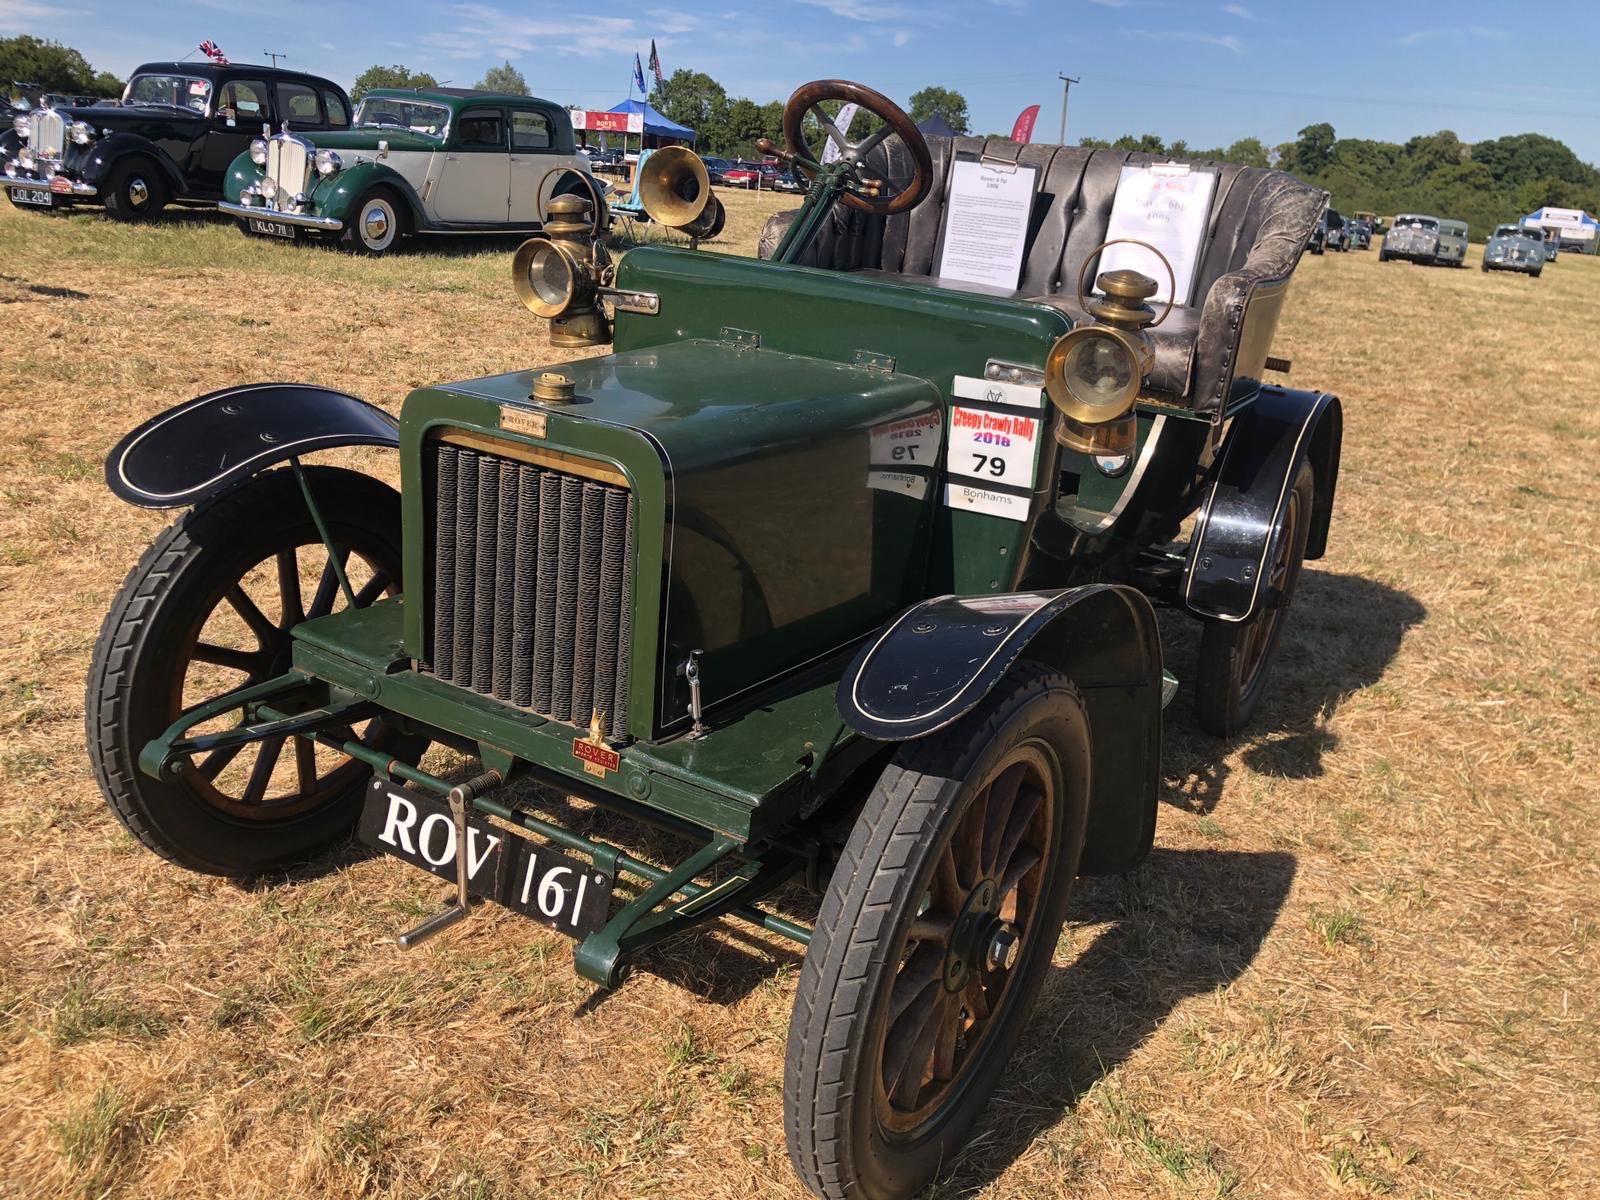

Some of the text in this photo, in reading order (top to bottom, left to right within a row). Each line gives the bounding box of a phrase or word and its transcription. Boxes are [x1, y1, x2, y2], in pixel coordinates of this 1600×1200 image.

[31, 191, 49, 202] 204
[256, 220, 274, 233] KLO
[508, 415, 539, 429] ROVER
[953, 407, 1035, 442] Creepy Crawly Rally
[973, 432, 1011, 448] 2018
[972, 453, 1006, 477] 79
[963, 487, 1013, 504] Bonhams
[578, 743, 614, 762] ROVER
[378, 792, 588, 927] ROV 161
